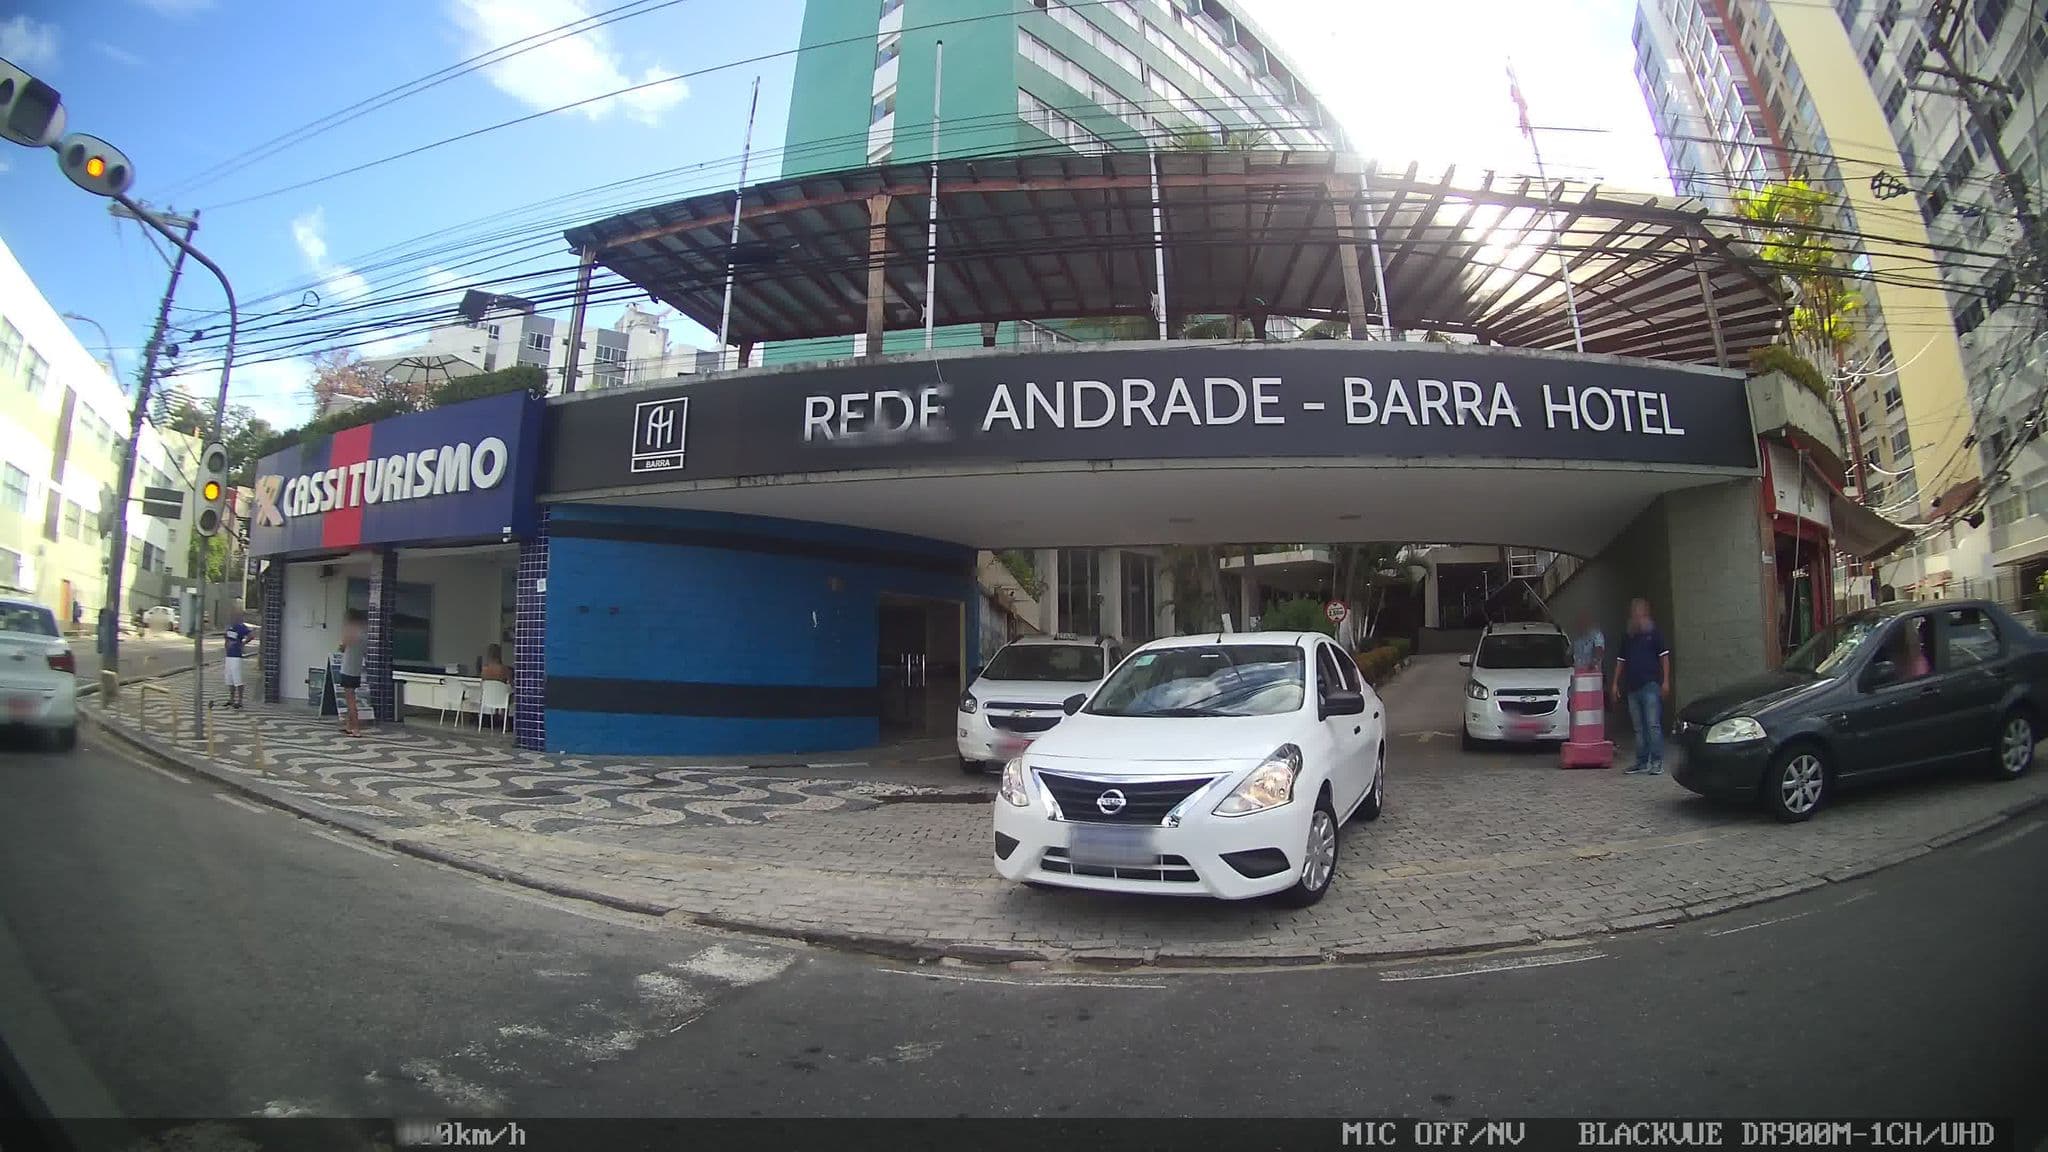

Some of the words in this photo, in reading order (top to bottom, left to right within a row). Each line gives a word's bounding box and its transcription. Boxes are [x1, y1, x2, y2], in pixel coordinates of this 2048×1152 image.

[981, 377, 1286, 431] ANDRADE
[1344, 377, 1522, 427] BARRA
[1542, 384, 1685, 435] HOTEL
[645, 459, 671, 469] BARRA
